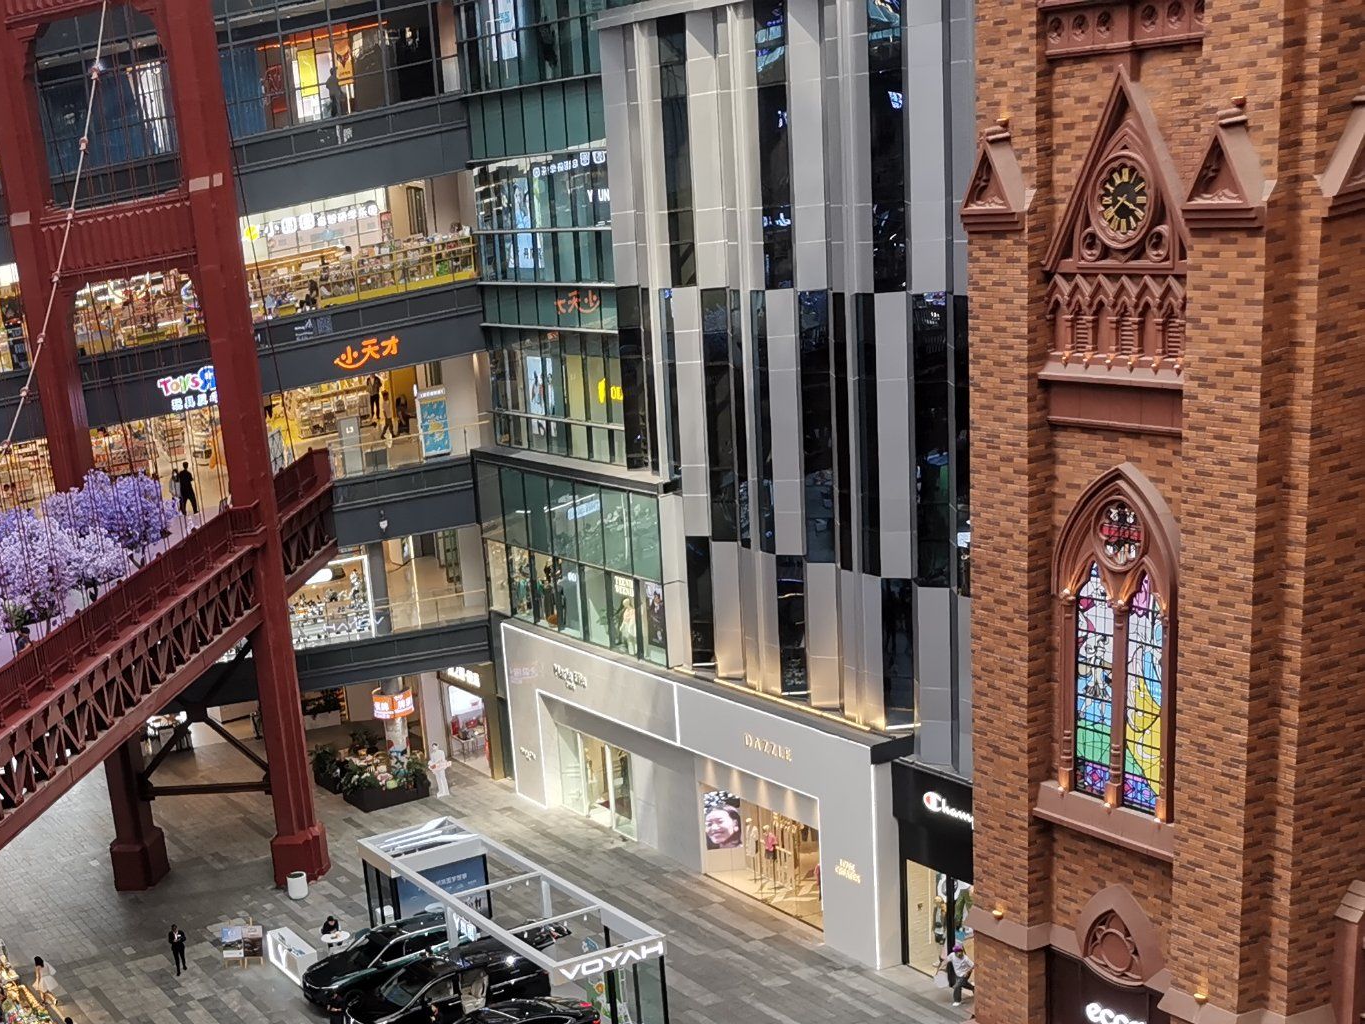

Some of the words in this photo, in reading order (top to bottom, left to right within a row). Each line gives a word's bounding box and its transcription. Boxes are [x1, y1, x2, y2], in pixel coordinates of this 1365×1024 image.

[333, 335, 399, 369] 小天才
[744, 732, 793, 762] DAZZLE
[559, 941, 663, 980] VOYAH
